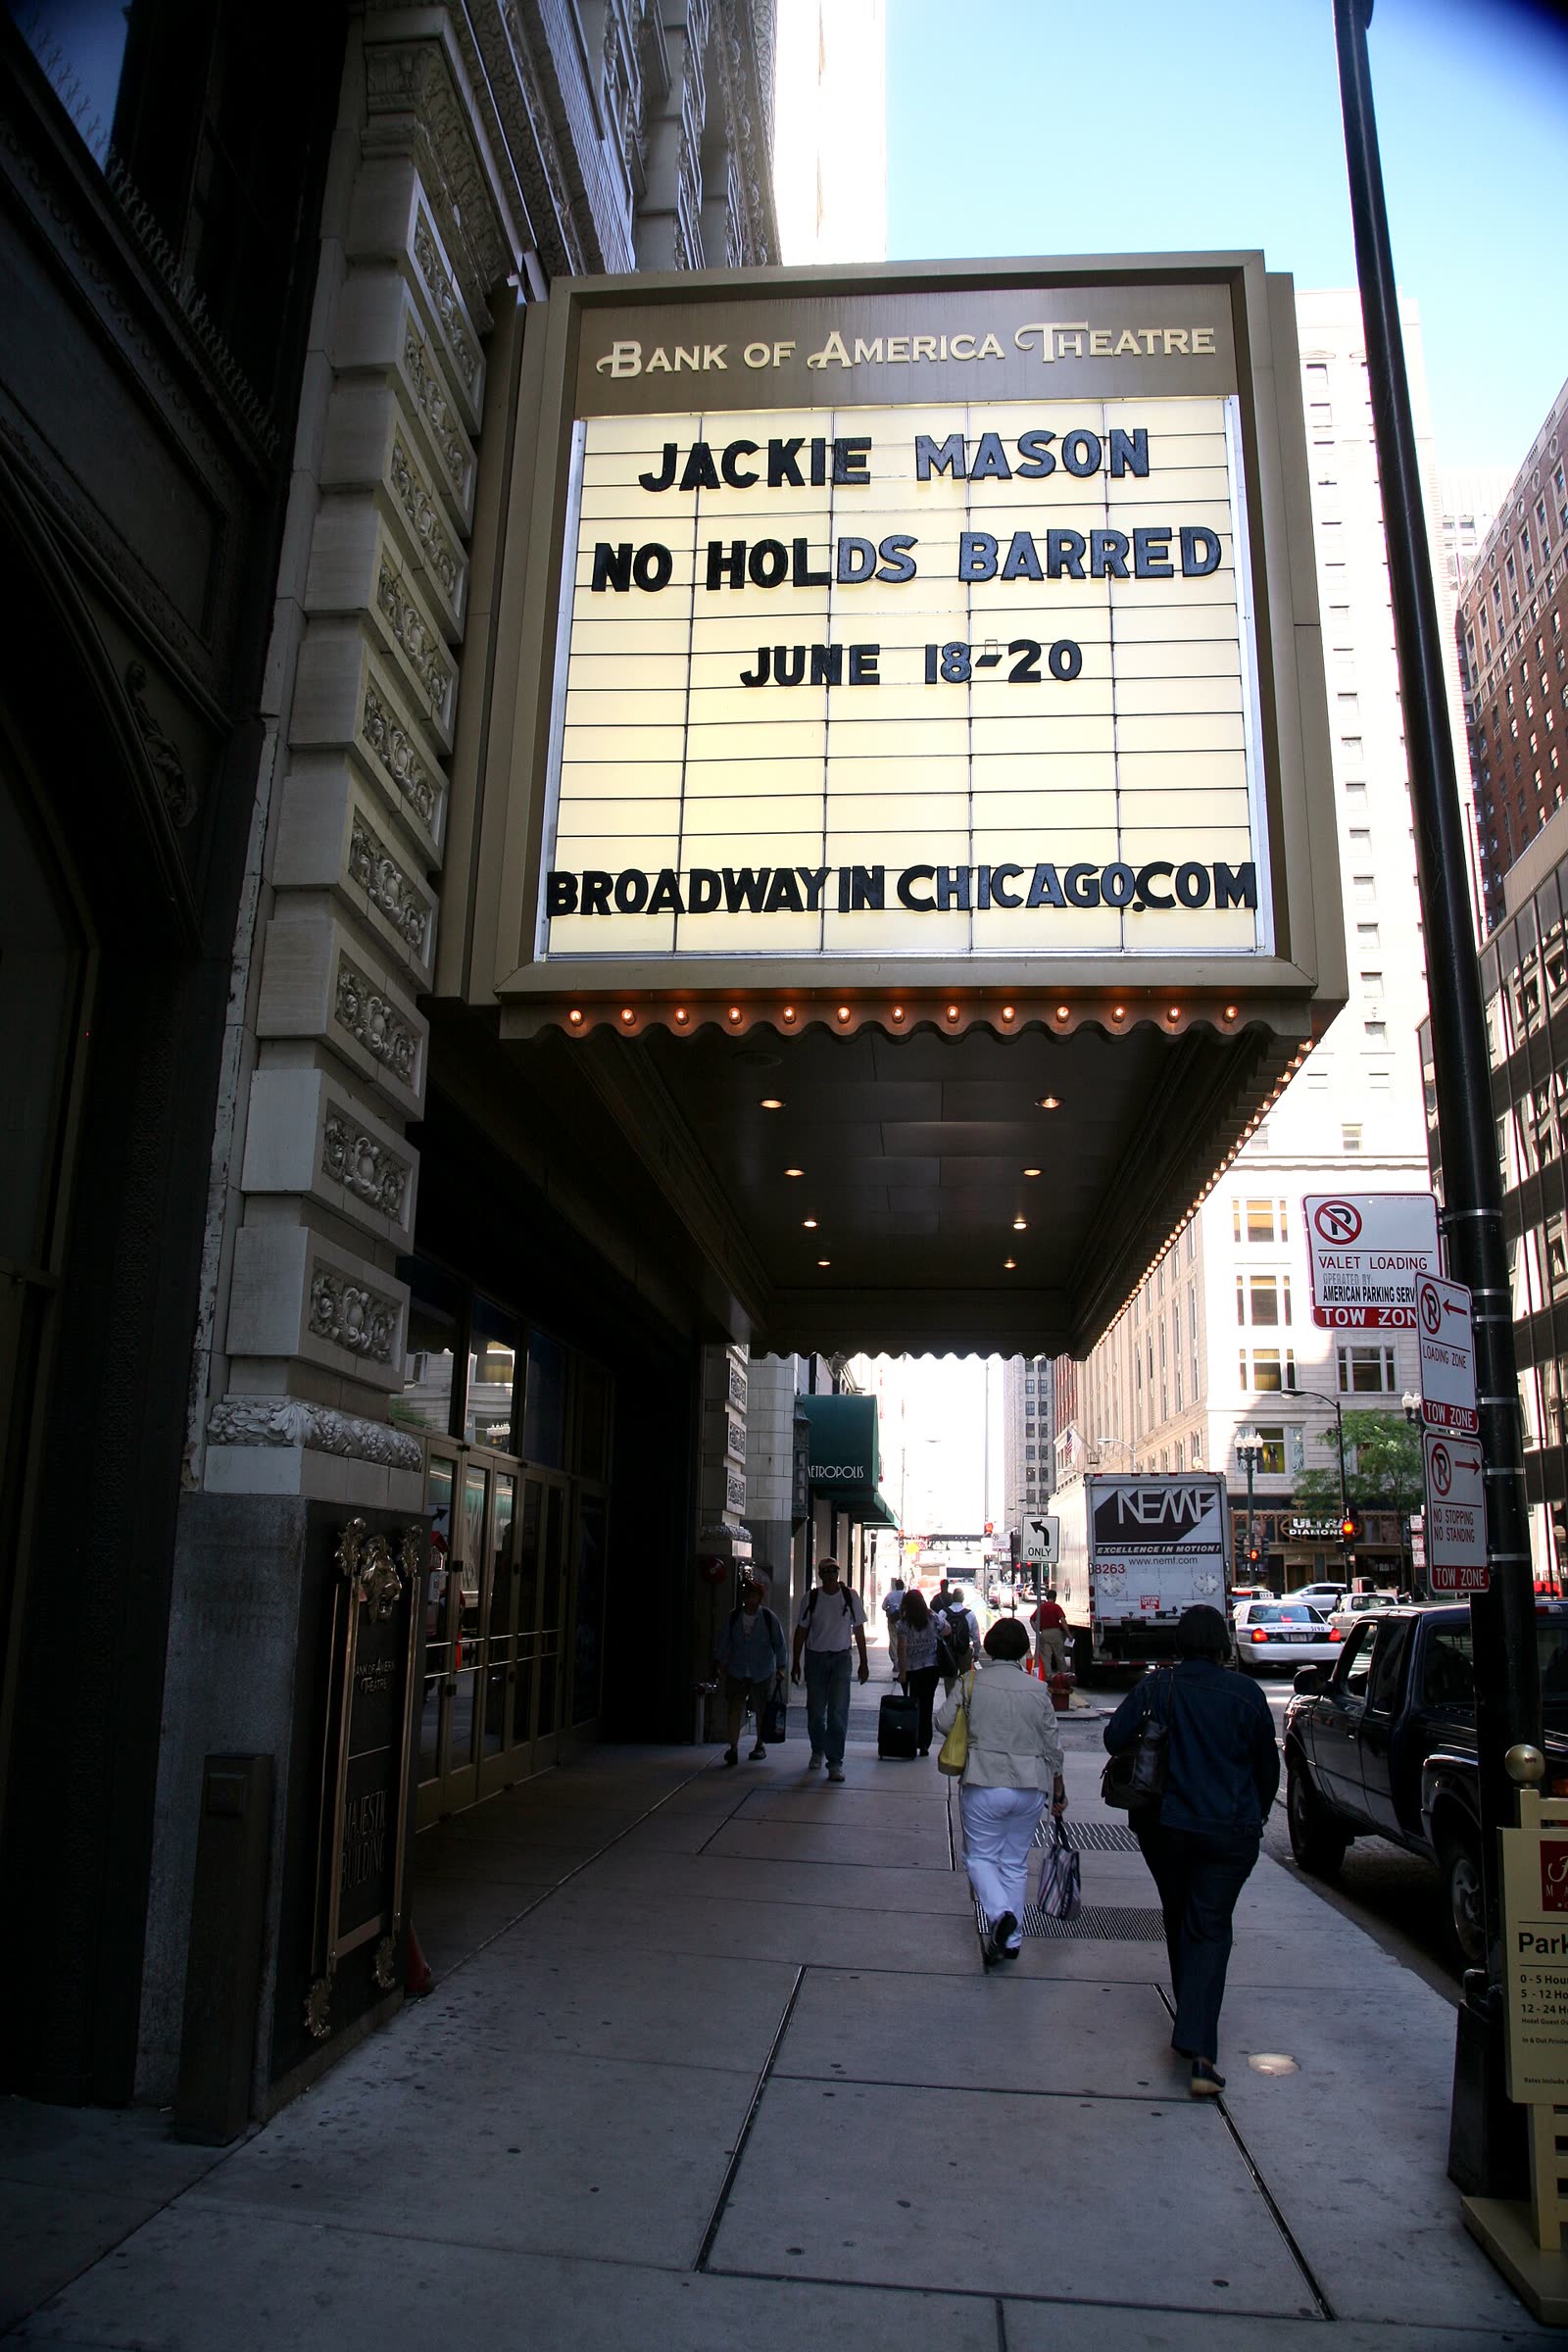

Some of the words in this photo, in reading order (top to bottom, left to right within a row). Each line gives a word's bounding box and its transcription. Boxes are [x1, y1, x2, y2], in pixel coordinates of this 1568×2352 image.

[595, 339, 727, 380] BANK
[742, 340, 796, 370] OF
[807, 329, 1005, 371] AMERICA
[1013, 320, 1216, 363] THEATRE
[638, 436, 872, 493] JACKIE
[914, 428, 1151, 481] MASON
[591, 542, 672, 592] NO
[706, 534, 918, 591] HOLDS
[958, 526, 1222, 582] BARRED
[739, 643, 881, 688] JUNE
[925, 638, 1083, 685] 18-20
[1318, 1256, 1361, 1269] VALET
[1369, 1256, 1428, 1270] LOADING
[1323, 1273, 1359, 1285] OPERATED
[1323, 1285, 1361, 1302] AMERICAN
[1362, 1286, 1395, 1302] PARKING
[1396, 1286, 1415, 1303] SERV
[1321, 1308, 1366, 1326] TOW
[1378, 1308, 1417, 1326] ZON
[1423, 1344, 1449, 1365] LOADING
[1451, 1352, 1467, 1369] ZONE
[1426, 1401, 1446, 1423] TOW
[1449, 1406, 1474, 1429] ZONE
[1116, 1489, 1216, 1524] NEMF
[1433, 1507, 1443, 1522] NO
[1445, 1509, 1474, 1526] STOPPING
[1434, 1527, 1444, 1542] NO
[1446, 1528, 1475, 1544] STANDING
[1028, 1545, 1052, 1557] ONLY
[1097, 1545, 1160, 1554] EXCELLENCE
[1094, 1563, 1125, 1574] 8263
[1128, 1555, 1198, 1566] www.nemf.com
[1435, 1567, 1455, 1587] TOW
[1458, 1568, 1486, 1588] ZONE
[355, 1661, 368, 1677] ANK
[1520, 1975, 1527, 1984] 0
[1536, 1975, 1543, 1984] 5
[1521, 1989, 1527, 1998] 5
[1539, 1989, 1551, 1998] 12
[1521, 2003, 1534, 2013] 12
[1543, 2004, 1556, 2014] 24
